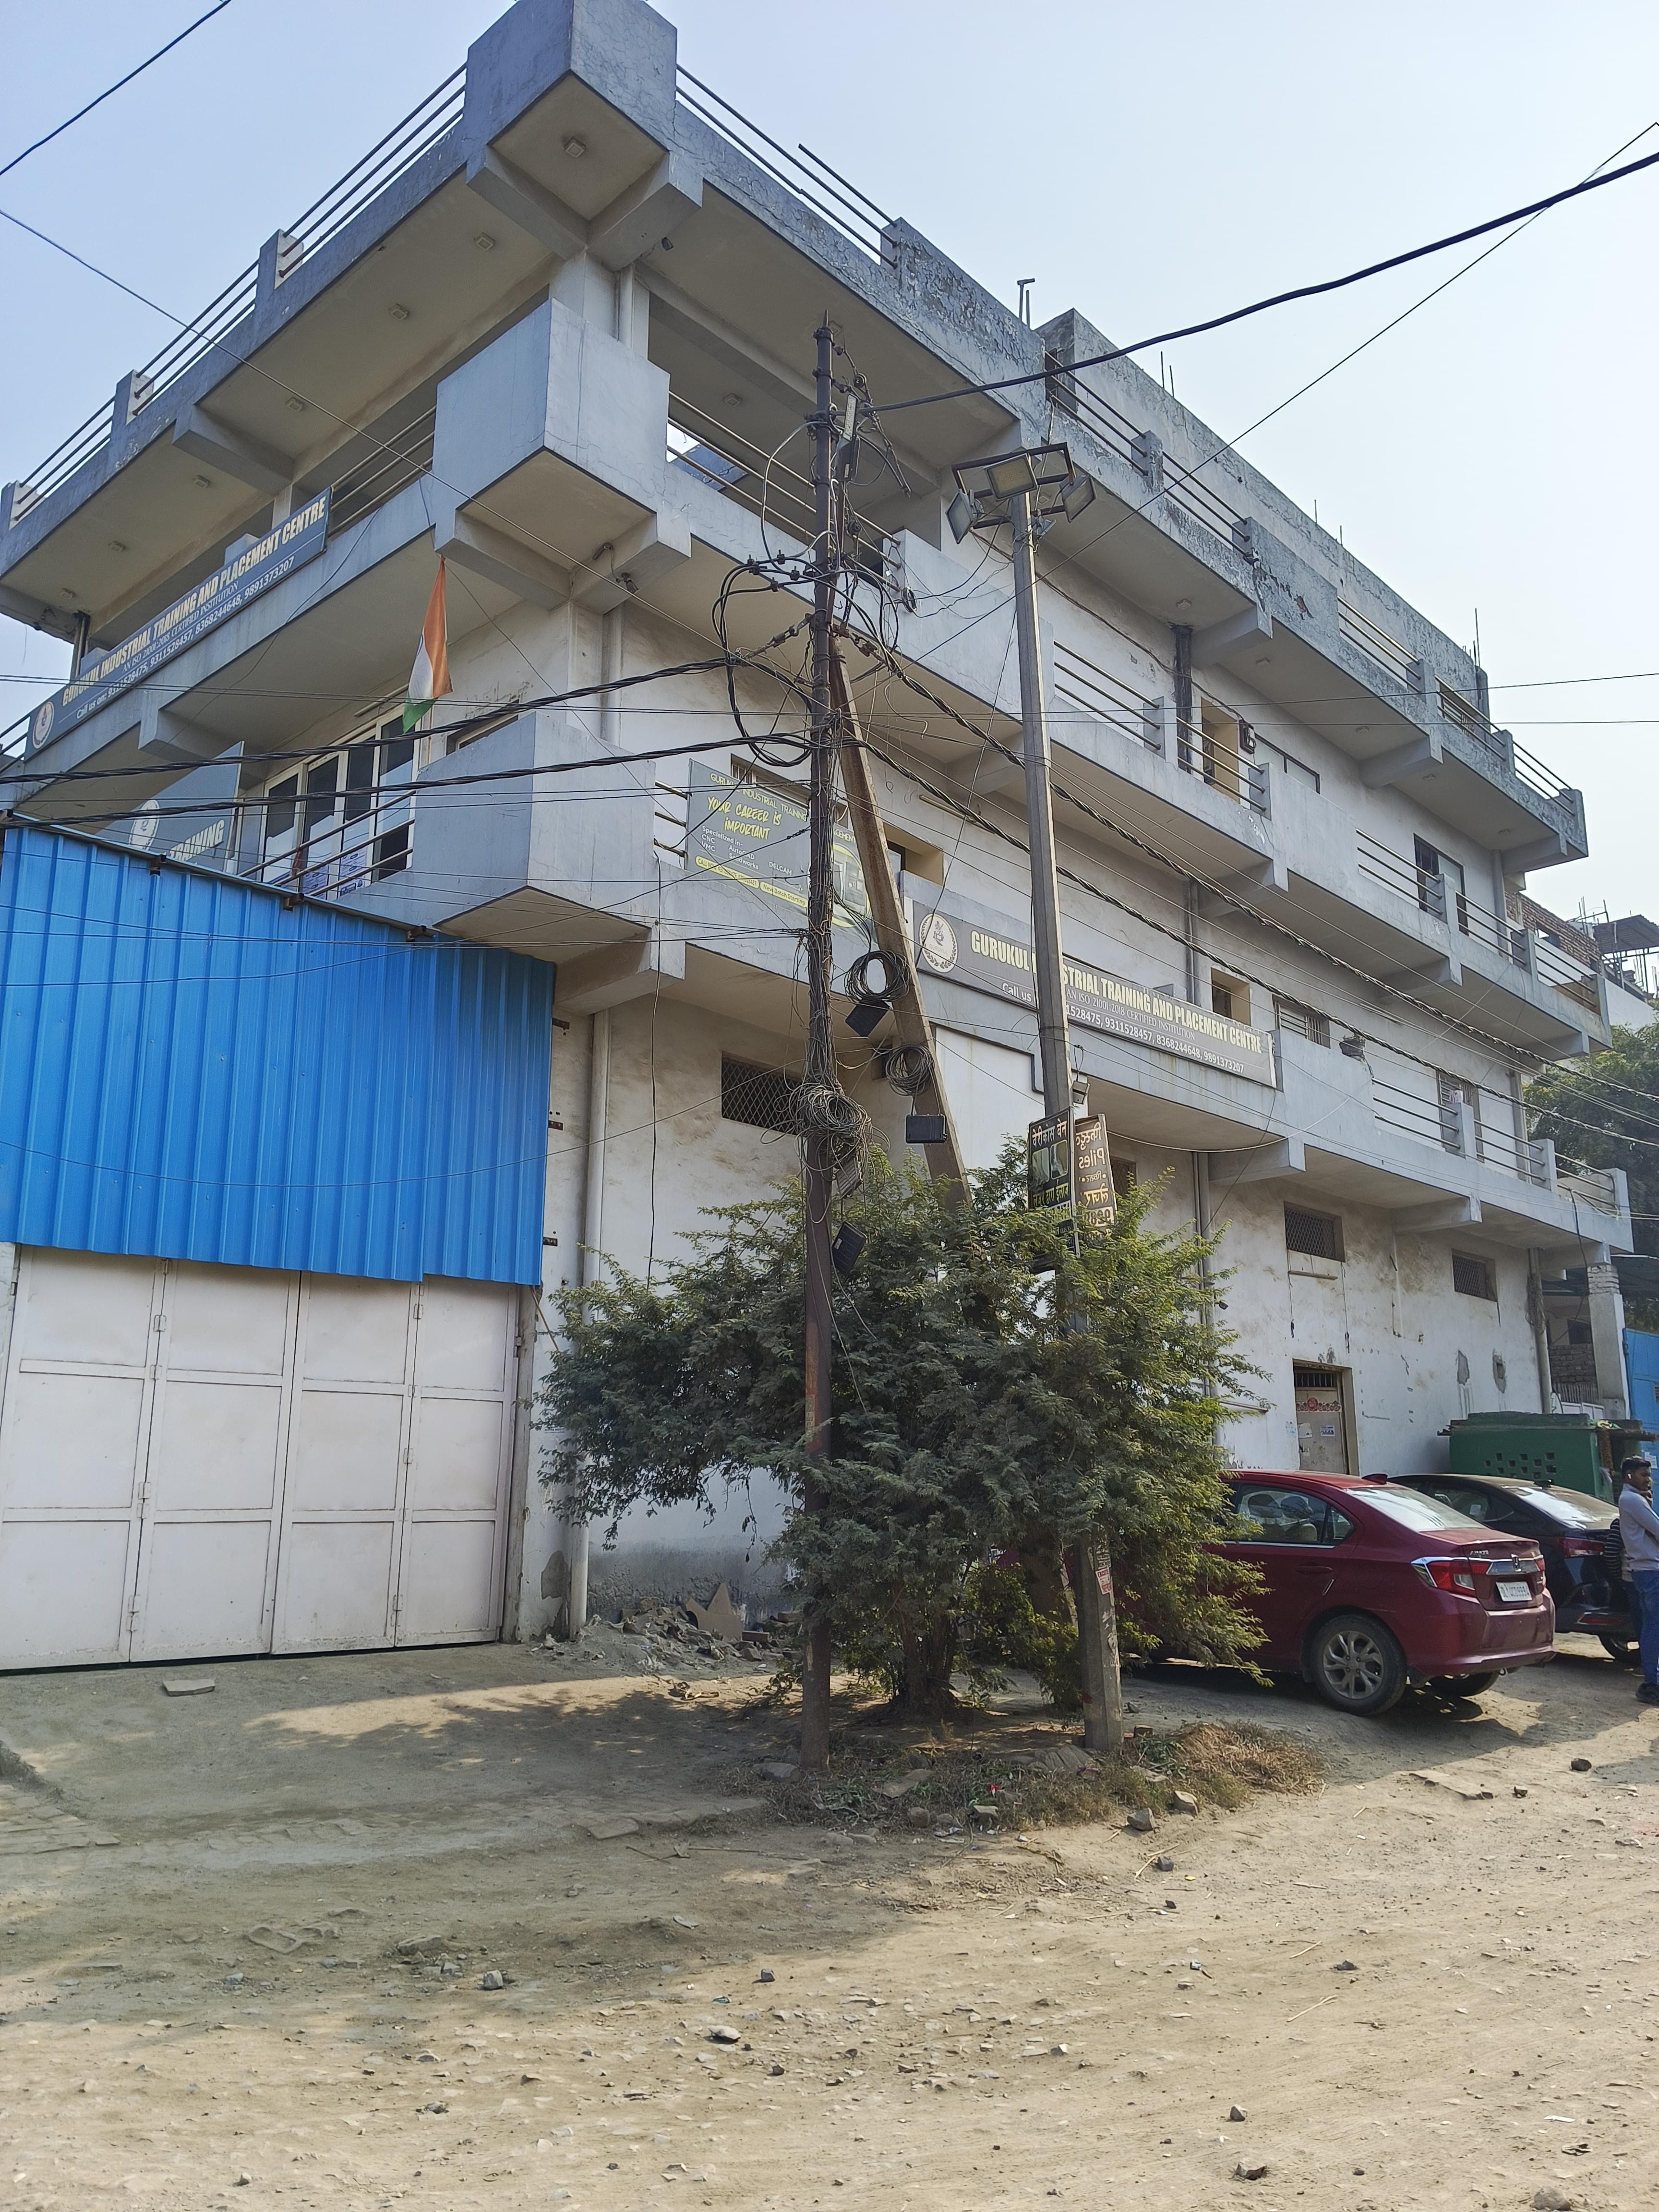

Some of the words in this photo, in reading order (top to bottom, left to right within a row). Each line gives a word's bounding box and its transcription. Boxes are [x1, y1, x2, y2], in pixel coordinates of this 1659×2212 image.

[62, 665, 99, 706] GURUKUL
[100, 627, 151, 679] INDUSTRIAL
[153, 592, 197, 640] TRAINING
[197, 576, 219, 607] AND
[219, 529, 282, 591] PLACEMENT
[282, 496, 326, 545] CENTRE
[76, 703, 88, 719] Call
[88, 700, 96, 711] us
[150, 629, 194, 668] 9311528457,
[195, 594, 242, 635] 8368244648,
[244, 556, 294, 600] 9891373207
[123, 661, 131, 673] AN
[132, 653, 141, 666] ISO
[143, 632, 170, 659] 21001:2018
[171, 610, 199, 637] CERTIFIED
[200, 581, 238, 616] INSTITUTION
[708, 796, 731, 814] YOUR
[735, 804, 769, 822] CAREER
[781, 803, 807, 822] TRAINING
[701, 834, 715, 844] CNC
[701, 841, 715, 852] VMC
[702, 825, 734, 844] Specialized
[729, 845, 755, 860] AutoCAD
[769, 861, 792, 875] DELCAM
[971, 930, 1030, 972] GURUKUL
[1100, 977, 1151, 1014] TRAINING
[1153, 997, 1173, 1021] AND
[1175, 1005, 1229, 1042] PLACEMENT
[1229, 1026, 1262, 1054] CENTRE
[1002, 983, 1018, 998] Call
[1021, 990, 1032, 1003] us
[1105, 1017, 1155, 1045] 9311528457,
[1156, 1034, 1203, 1061] 8368244648,
[1203, 1051, 1244, 1073] 9891373207
[1067, 988, 1077, 999] AN
[1079, 992, 1090, 1004] ISO
[1093, 997, 1125, 1016] 21001:2018
[1127, 1009, 1157, 1027] CERTIFIED
[1158, 1021, 1195, 1041] INSTITUTION
[1032, 1124, 1055, 1148] वेरीकोस
[1057, 1118, 1067, 1138] वेन
